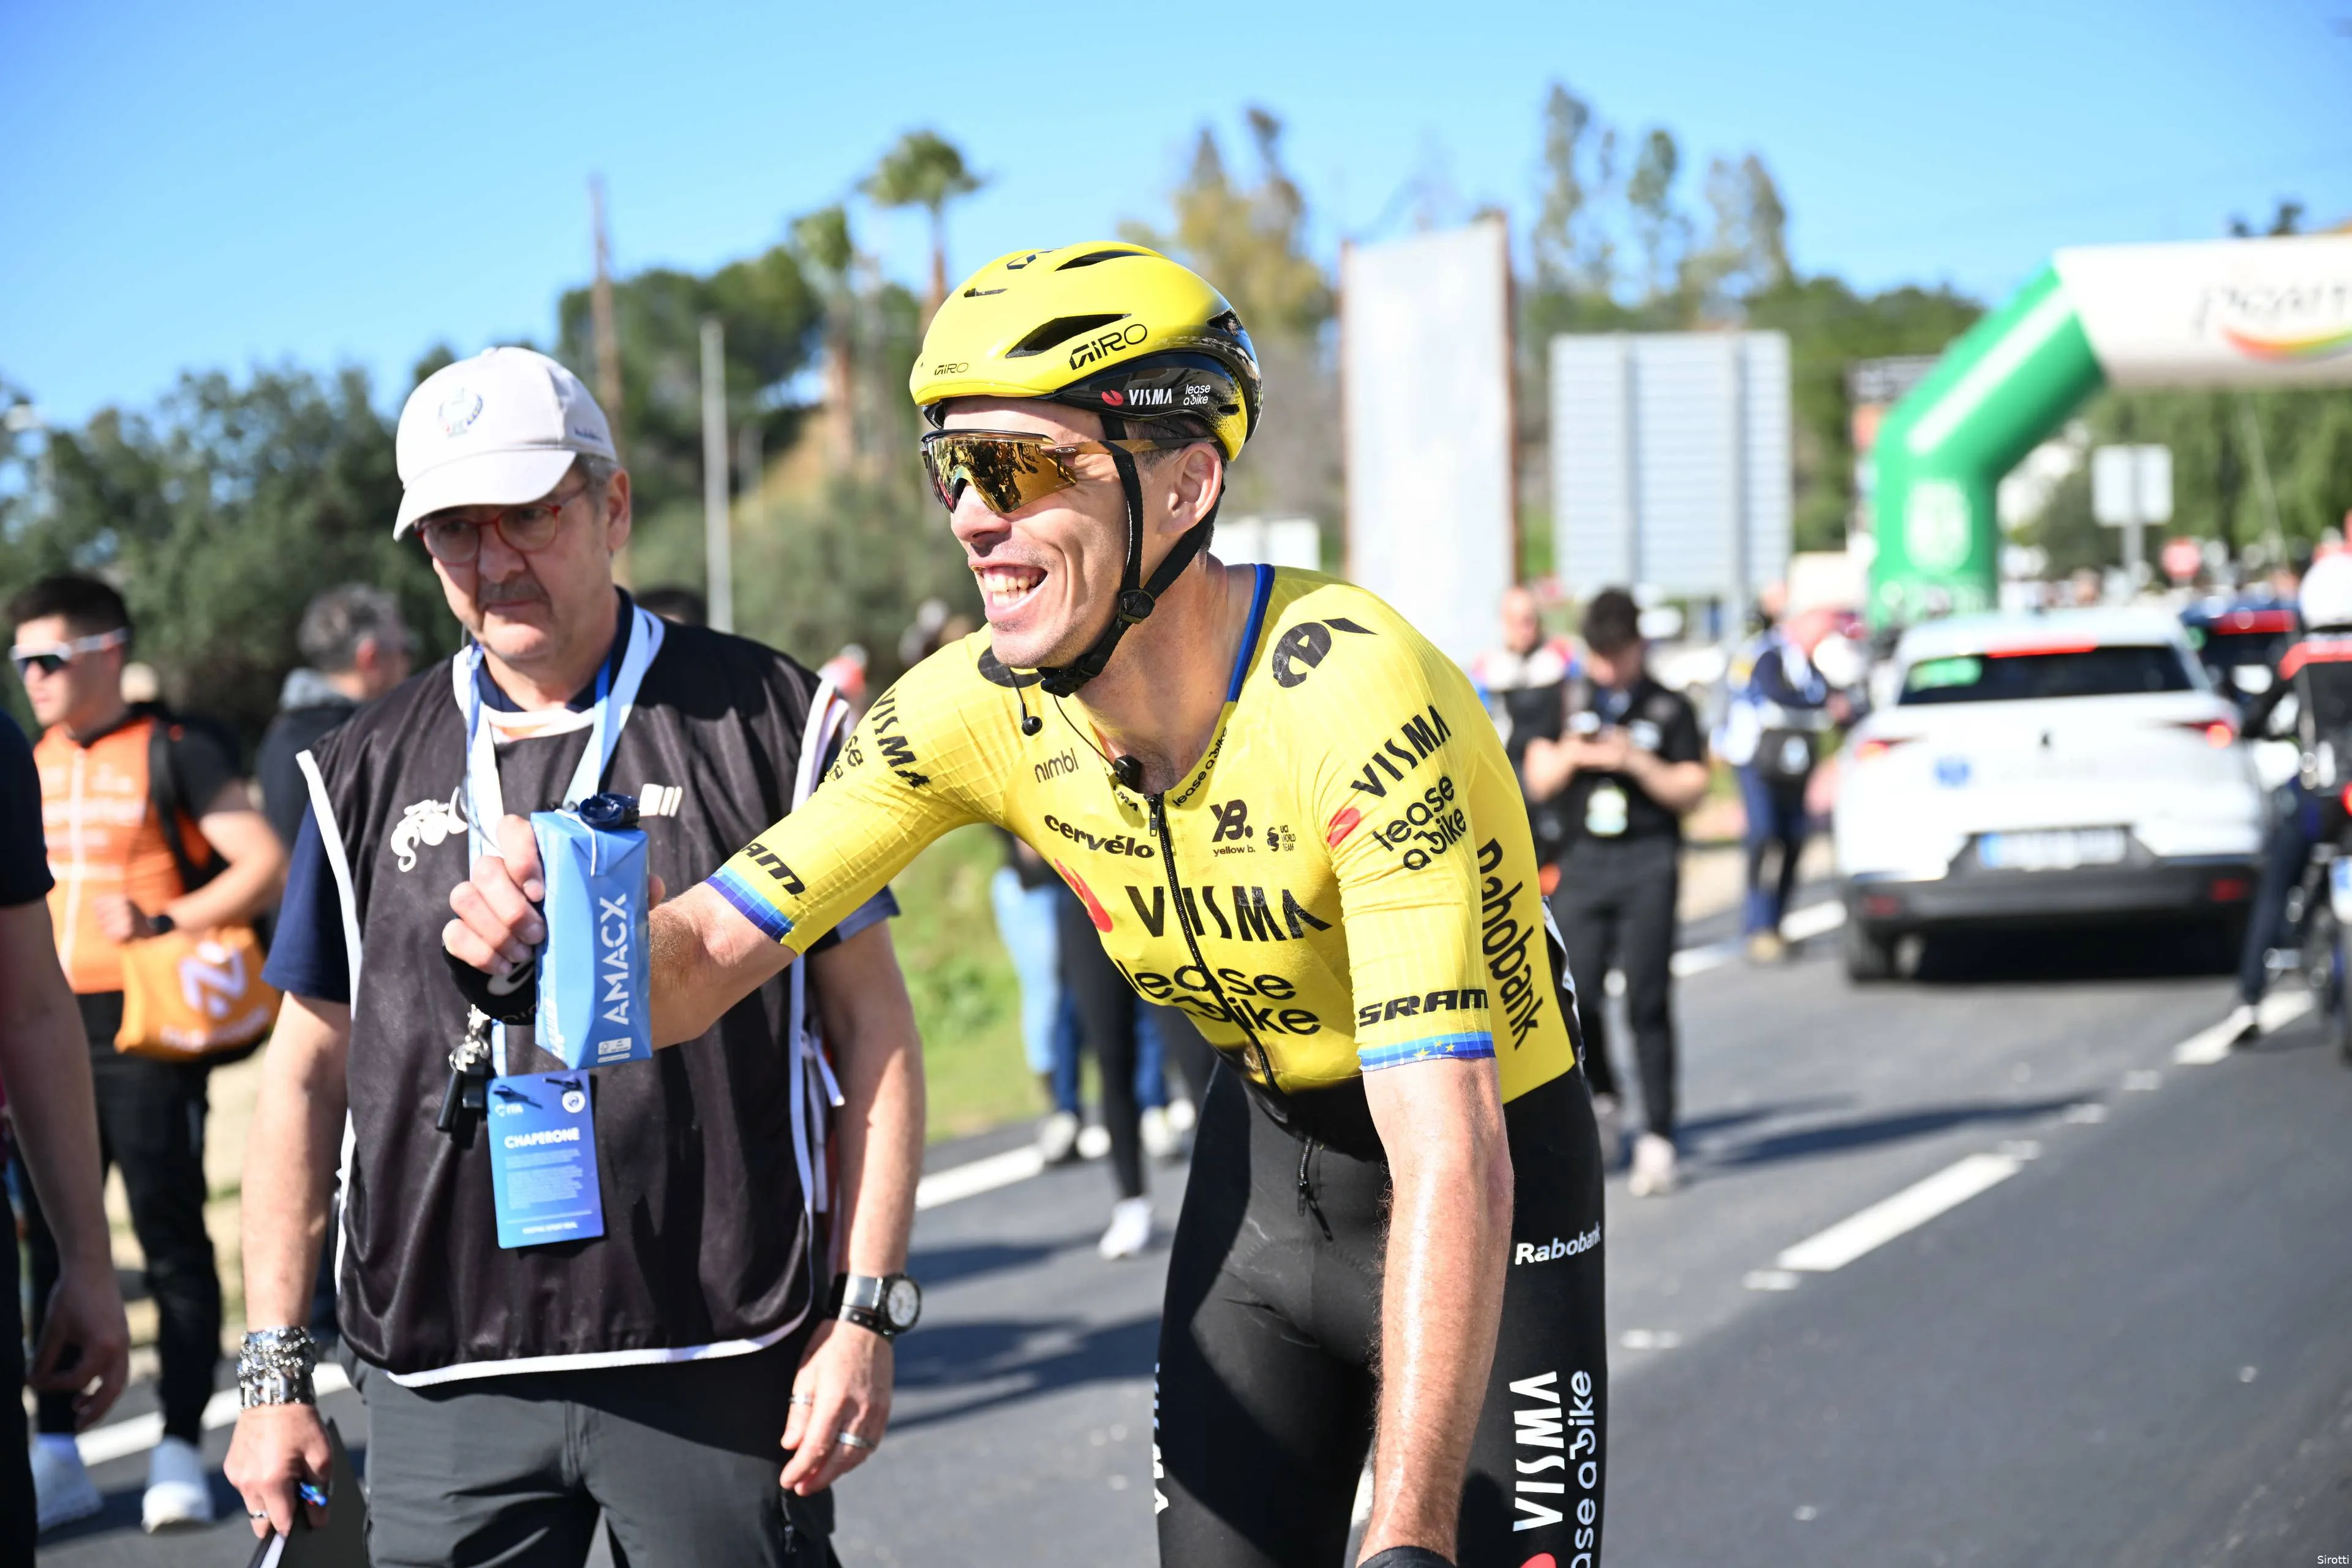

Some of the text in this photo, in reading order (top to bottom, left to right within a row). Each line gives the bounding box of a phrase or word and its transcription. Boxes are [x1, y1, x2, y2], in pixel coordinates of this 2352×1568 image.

[1069, 323, 1148, 371] GIRO
[1129, 388, 1173, 406] VISMA
[1185, 384, 1211, 395] lease
[872, 687, 930, 789] VISMA
[1350, 704, 1452, 798] VISMA
[1034, 747, 1079, 783] nimbl
[1172, 771, 1207, 807] lease
[1280, 824, 1289, 834] UCI
[1371, 775, 1455, 853] lease
[1044, 814, 1155, 859] cervélo
[1213, 844, 1256, 858] yellow b.
[1281, 833, 1296, 843] WORLD
[1282, 842, 1295, 852] TEAM
[1124, 885, 1333, 942] VISMA
[599, 892, 630, 1026] AMACX
[1115, 958, 1297, 1000] lease
[1359, 989, 1489, 1028] SRAM
[504, 1126, 581, 1149] CHAPERONE
[1514, 1220, 1601, 1266] Rabobank
[1509, 1371, 1566, 1532] VISMA
